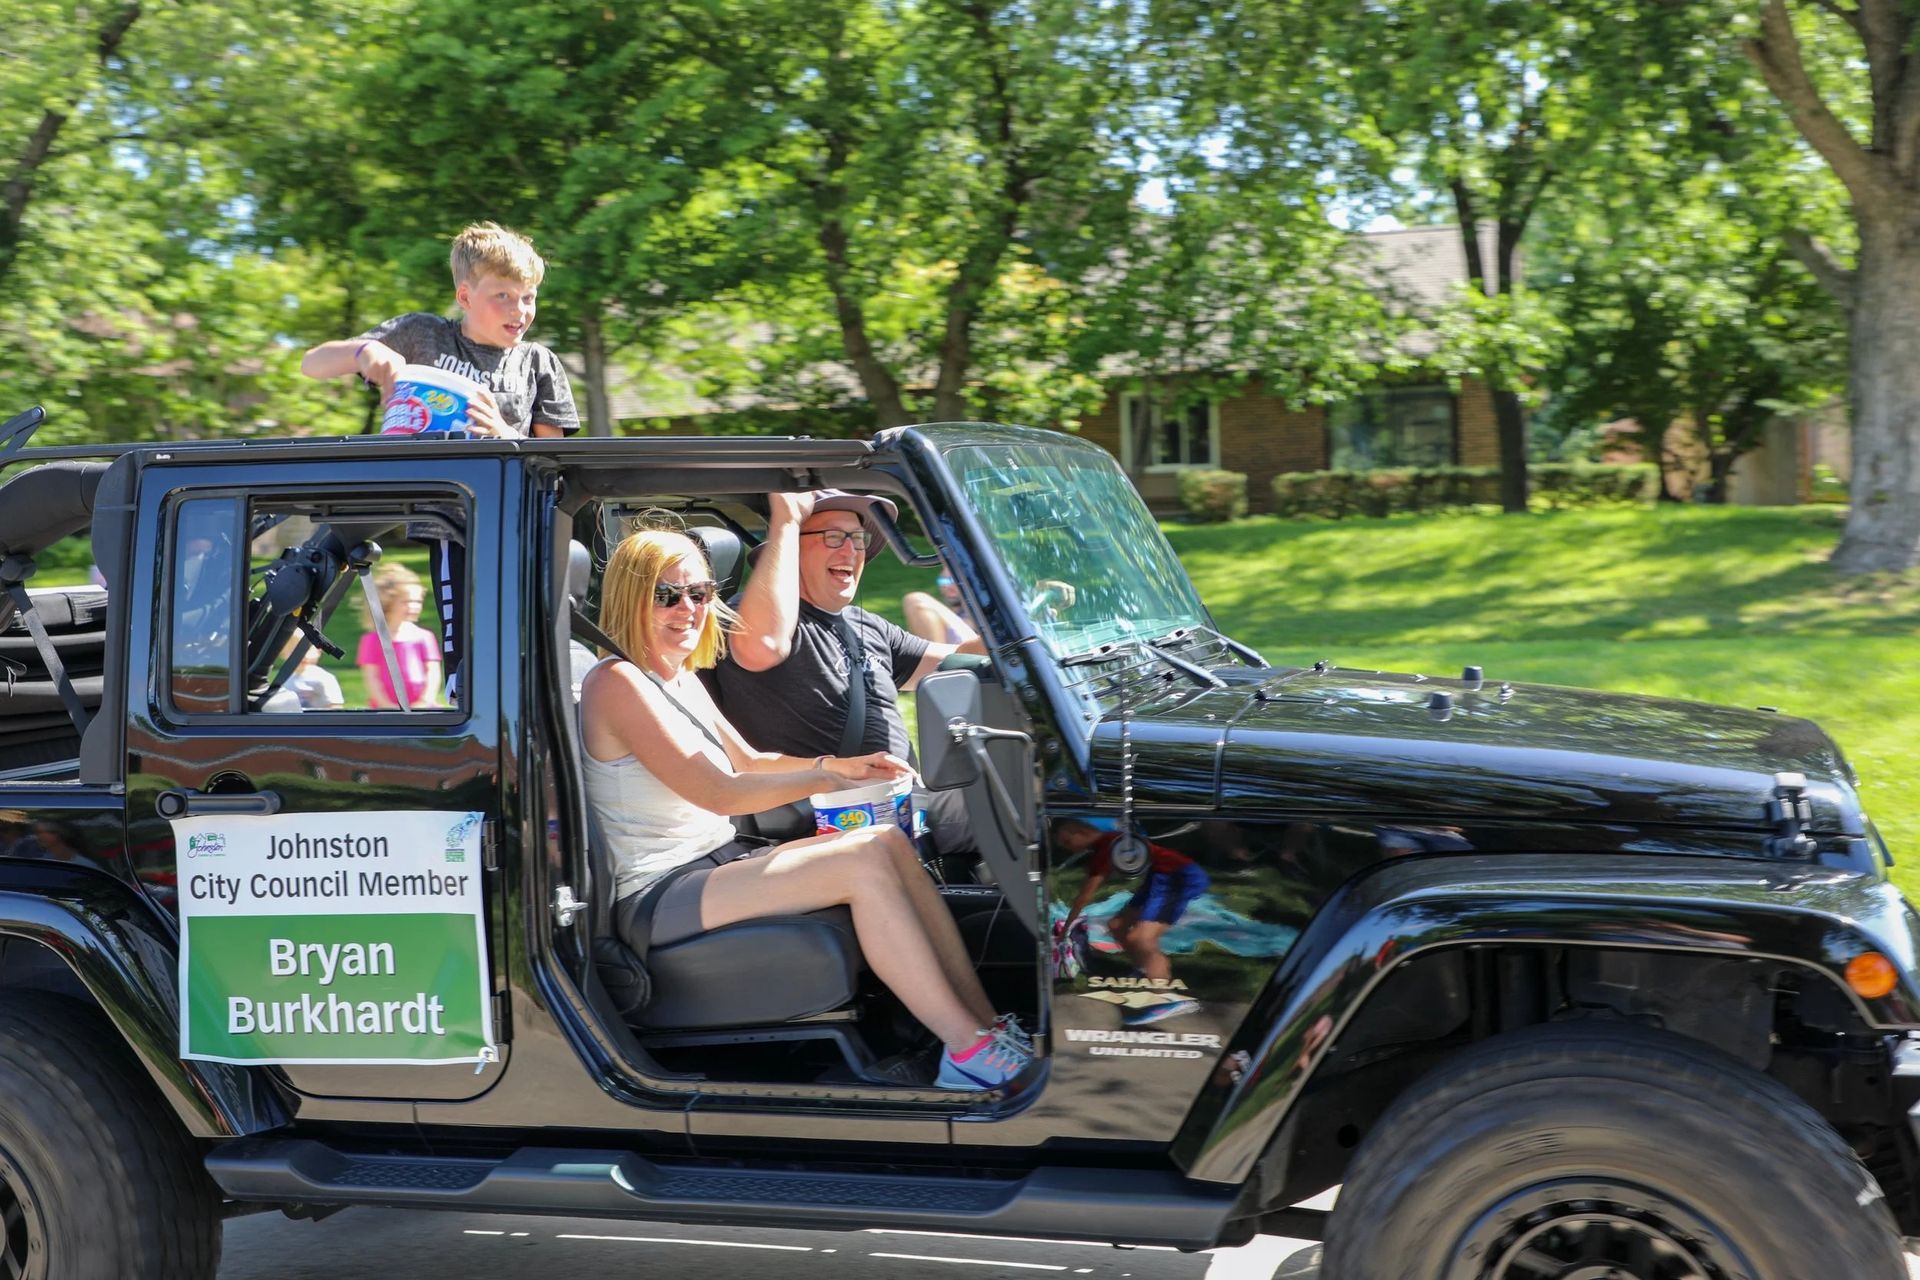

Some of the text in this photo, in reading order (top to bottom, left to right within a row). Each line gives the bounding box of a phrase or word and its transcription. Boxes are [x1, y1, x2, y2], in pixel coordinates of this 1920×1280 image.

[434, 352, 522, 392] JOHNSTO
[267, 833, 388, 859] Johnston
[190, 870, 468, 904] City Council Member
[270, 939, 394, 985] Bryan
[1087, 976, 1188, 989] SAHARA
[228, 993, 445, 1035] Burkhardt
[1064, 1029, 1222, 1048] WRANGLER
[1089, 1047, 1203, 1059] UNLIMITED
